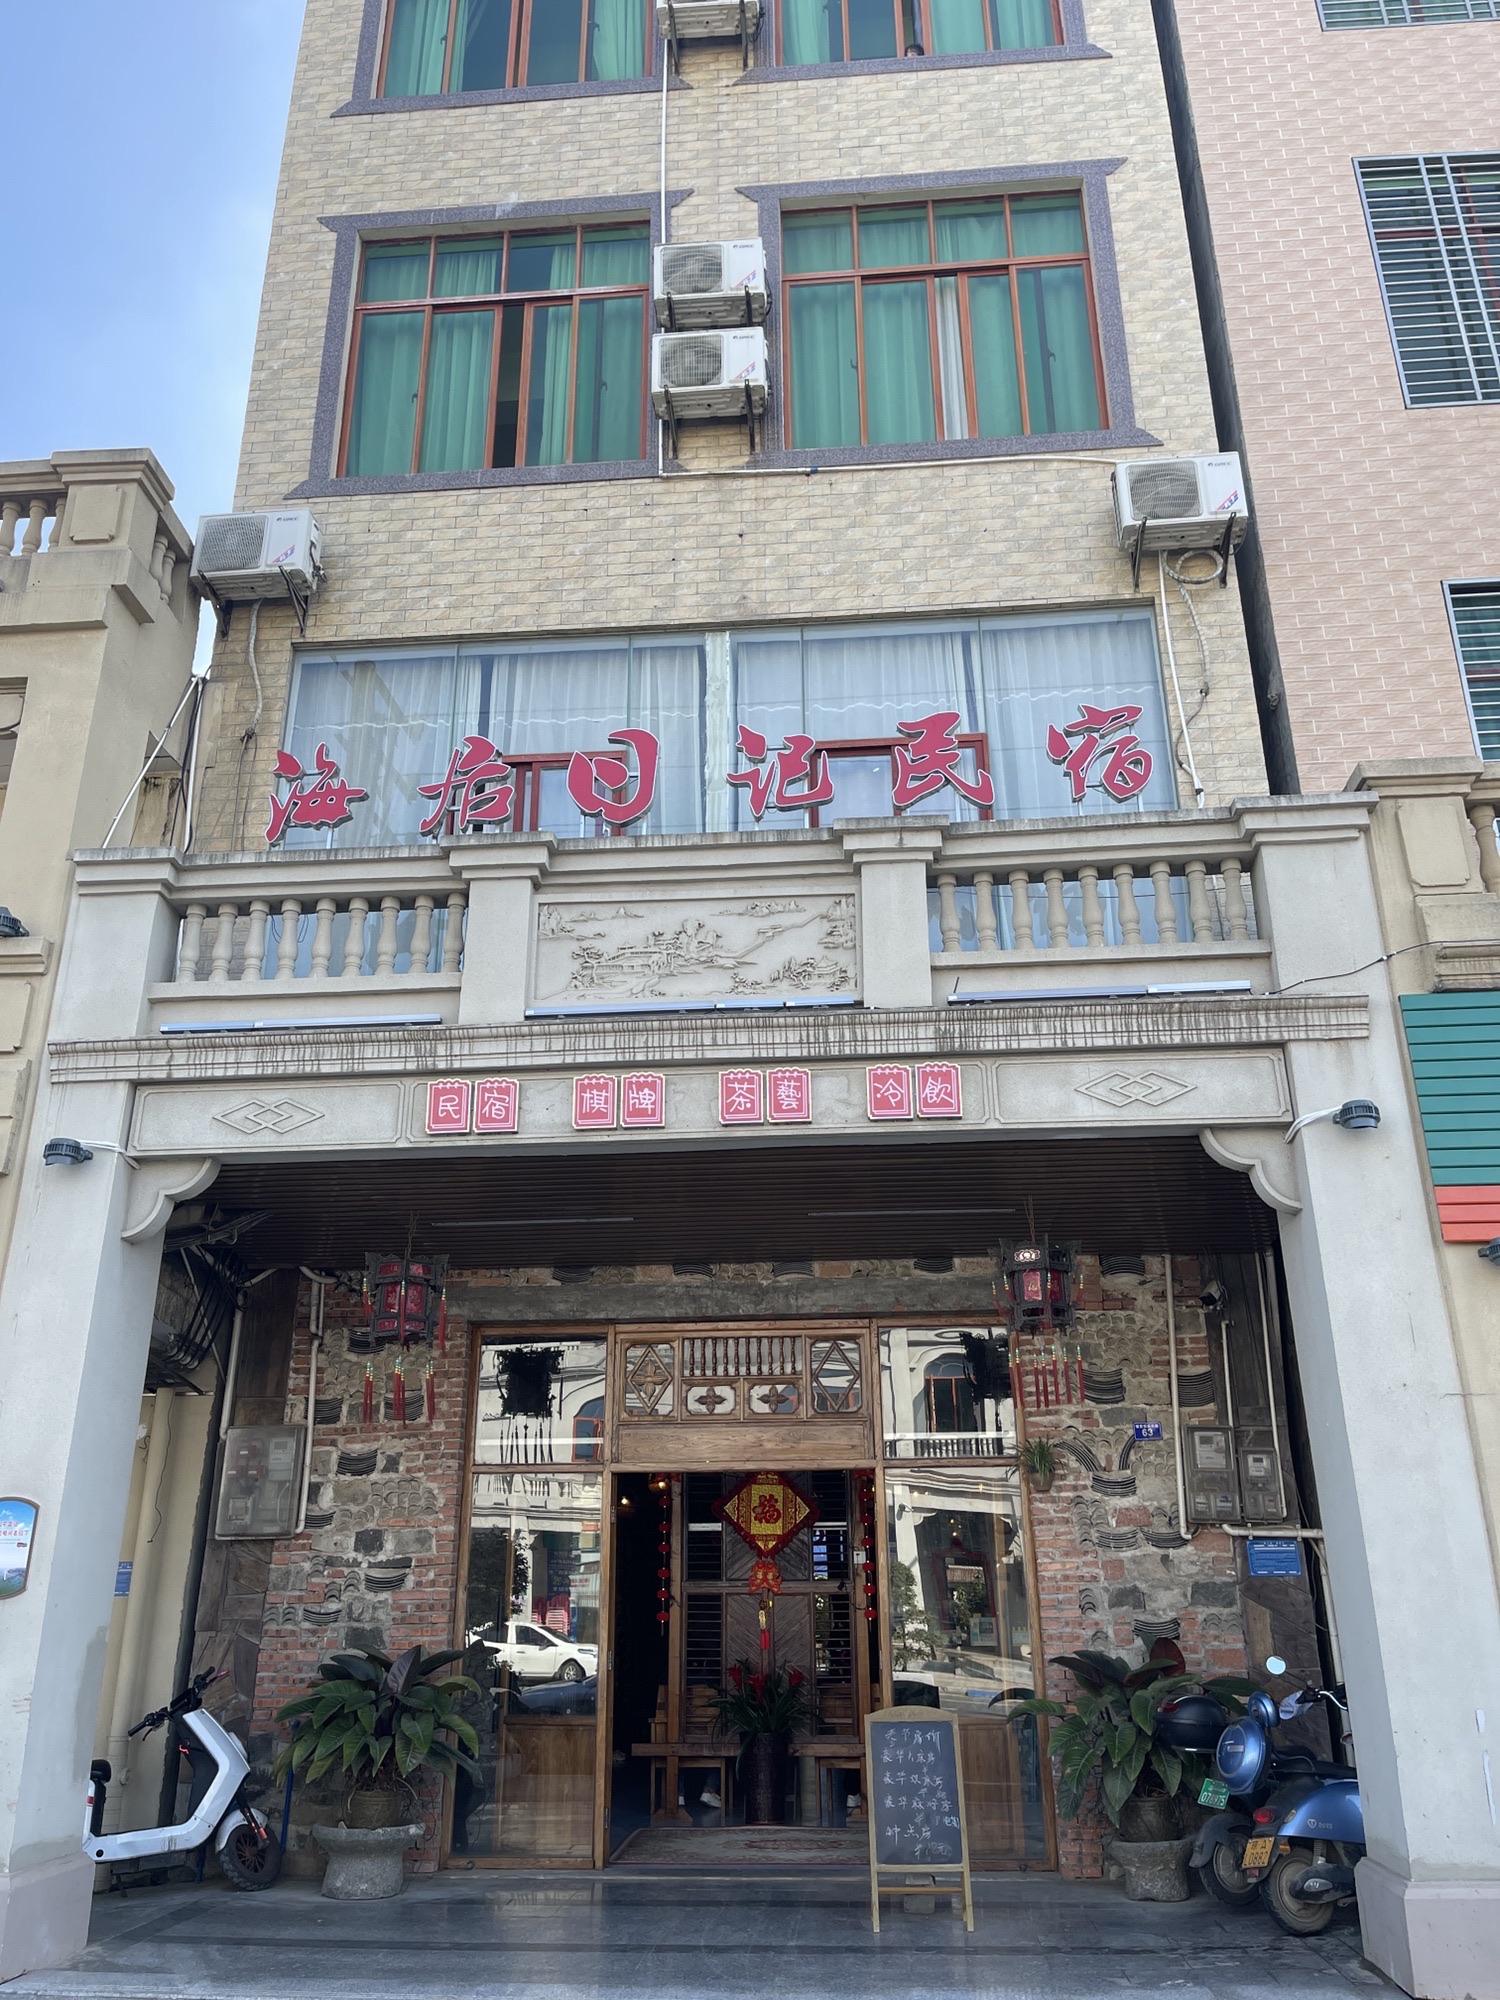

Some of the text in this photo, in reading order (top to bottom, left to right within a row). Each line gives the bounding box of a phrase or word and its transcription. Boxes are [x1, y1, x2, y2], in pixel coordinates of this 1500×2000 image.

[265, 703, 1154, 848] 海后日记民宿
[438, 1076, 954, 1119] 民宿 棋牌 茶藝 冷飲
[1141, 1428, 1154, 1437] 63
[752, 1493, 782, 1524] 福
[885, 1823, 932, 1846] 钟点房
